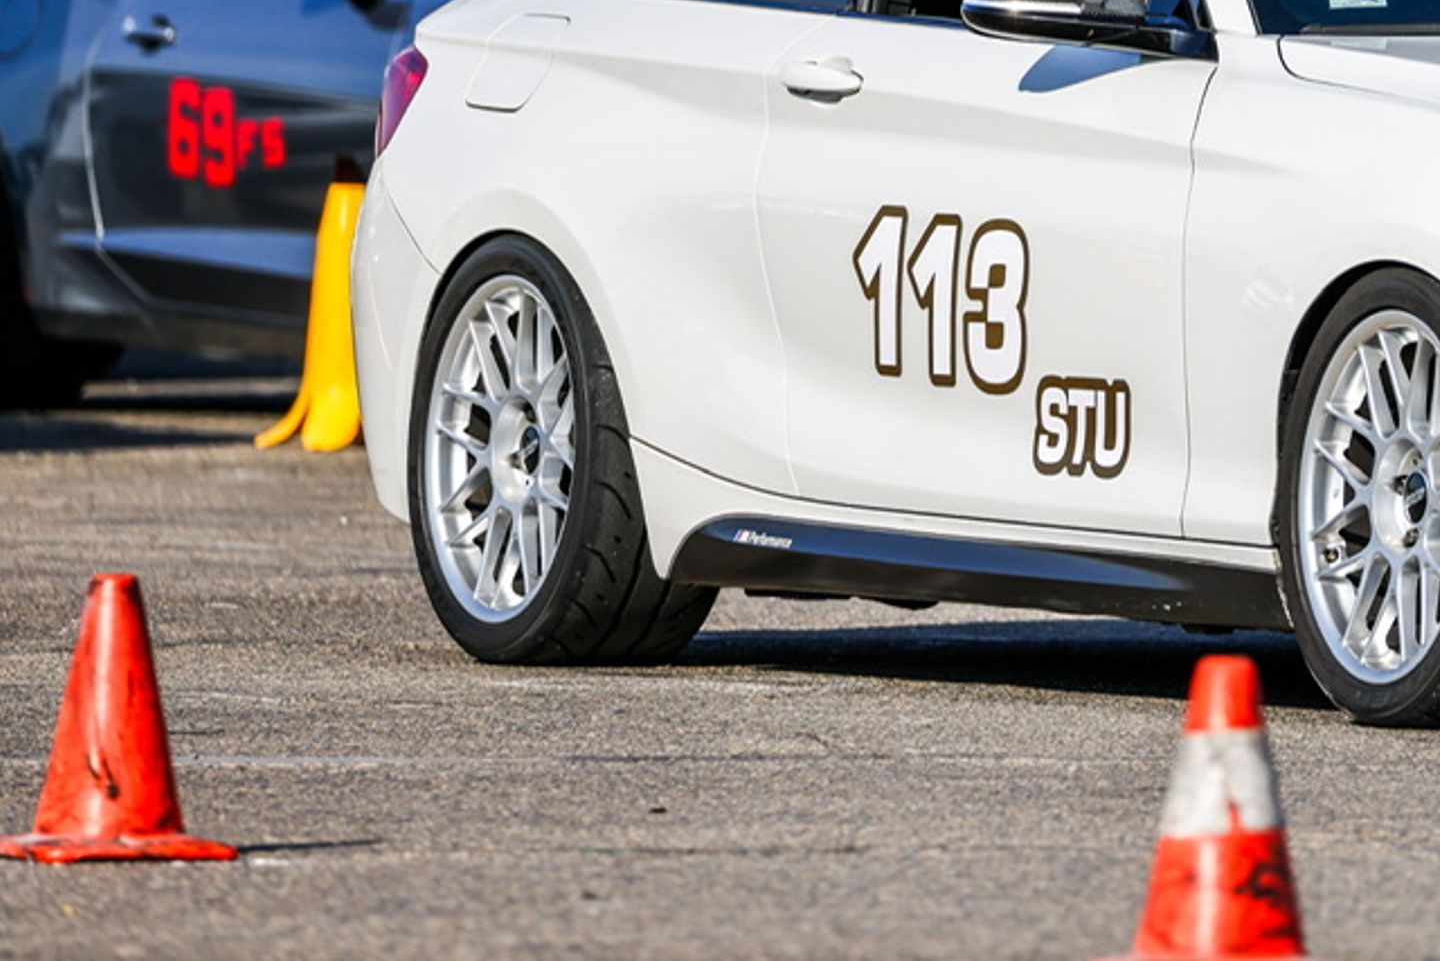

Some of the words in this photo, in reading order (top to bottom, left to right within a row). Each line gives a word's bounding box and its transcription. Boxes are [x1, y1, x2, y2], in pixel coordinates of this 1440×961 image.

[168, 76, 236, 188] 69
[853, 205, 1029, 395] 113
[1032, 375, 1131, 479] STU
